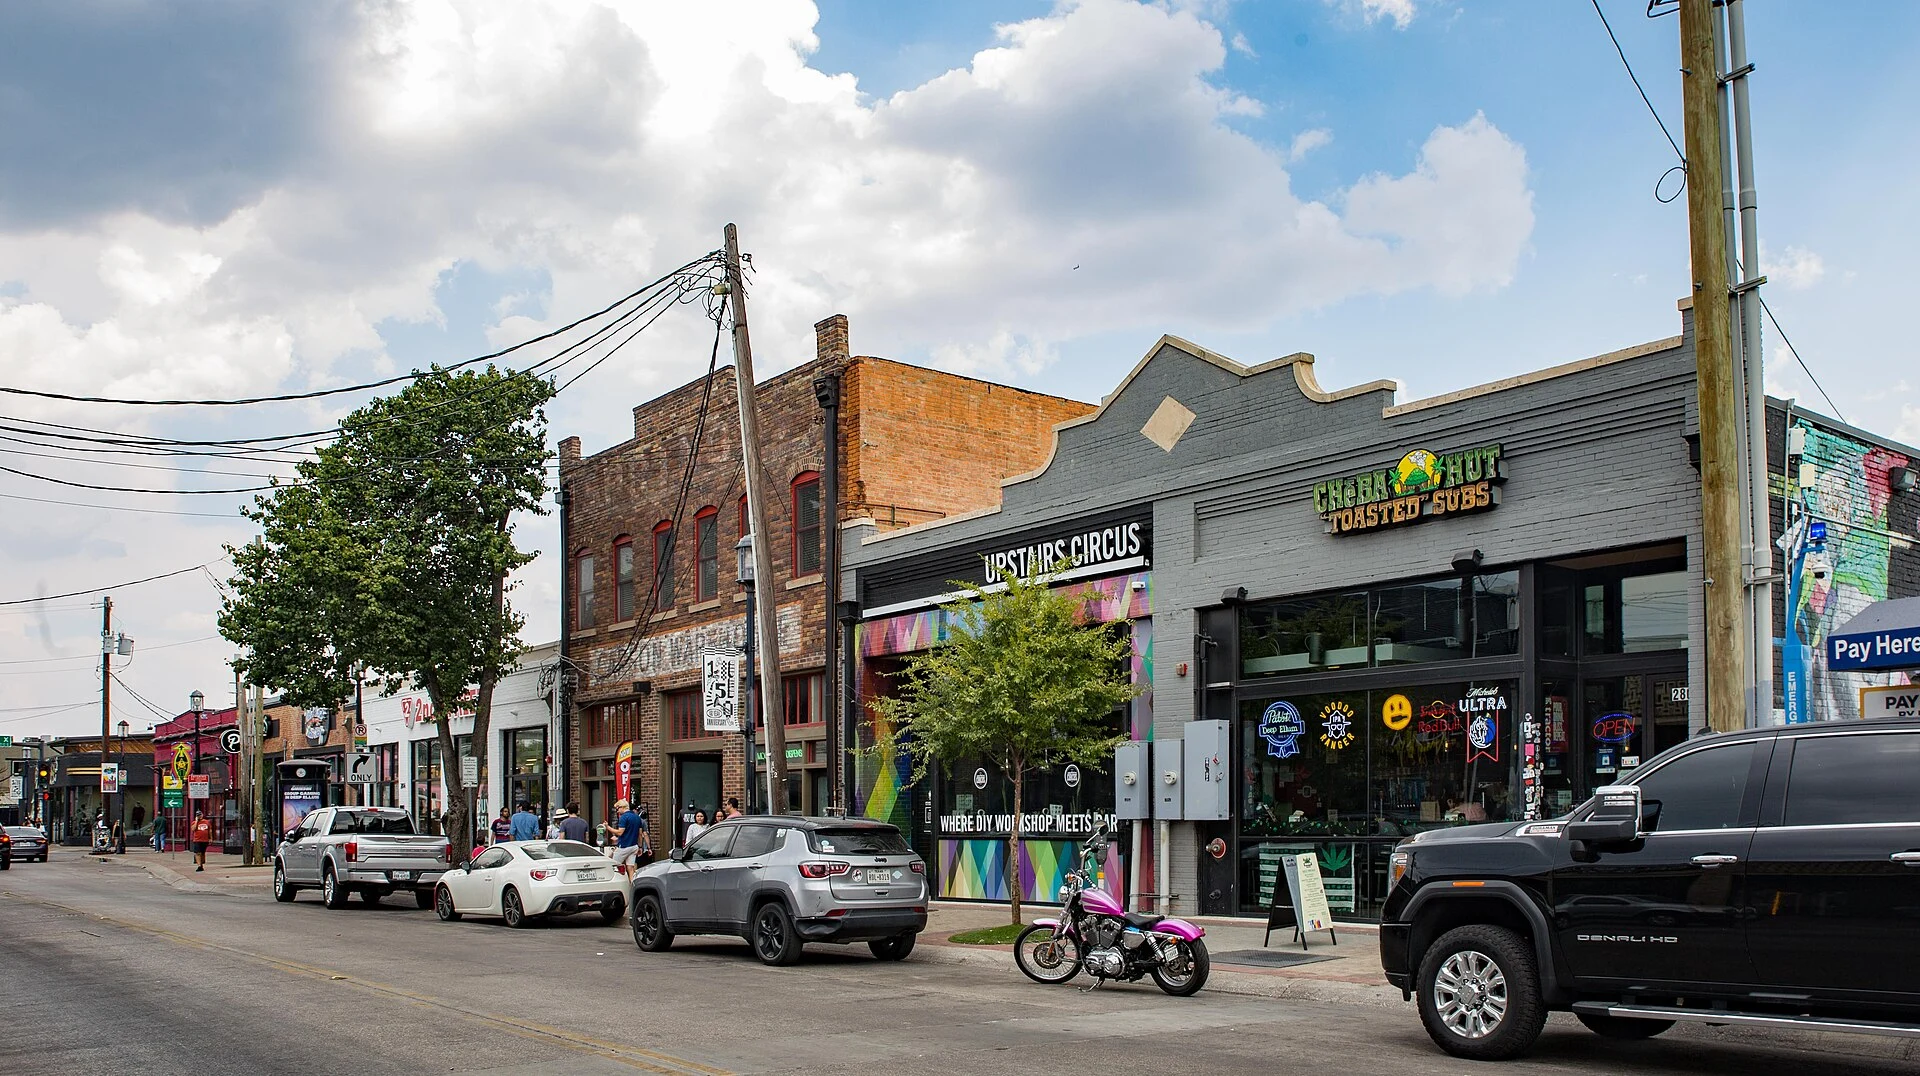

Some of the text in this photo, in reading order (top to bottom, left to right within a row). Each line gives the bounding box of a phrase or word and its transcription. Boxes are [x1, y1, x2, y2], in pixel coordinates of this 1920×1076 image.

[1444, 443, 1501, 487] HUT
[1433, 482, 1490, 515] SUBS
[984, 522, 1141, 583] UPSTAIRS CIRCUS
[1835, 635, 1920, 662] Pay Here
[1466, 687, 1498, 698] Michelob
[1459, 696, 1507, 712] ULTRA
[1885, 694, 1919, 709] PAY
[1268, 709, 1291, 723] Pabst
[1320, 702, 1354, 719] VOODOO
[1333, 715, 1342, 723] IPA
[1262, 725, 1299, 735] Deep Ellum
[1593, 717, 1635, 738] OPEN
[1320, 732, 1355, 750] RANGER
[351, 774, 372, 782] ONLY
[940, 814, 974, 832] WHERE
[976, 814, 993, 832] DIY
[1056, 814, 1092, 832] MEETS
[1577, 934, 1678, 943] DENALI HD
